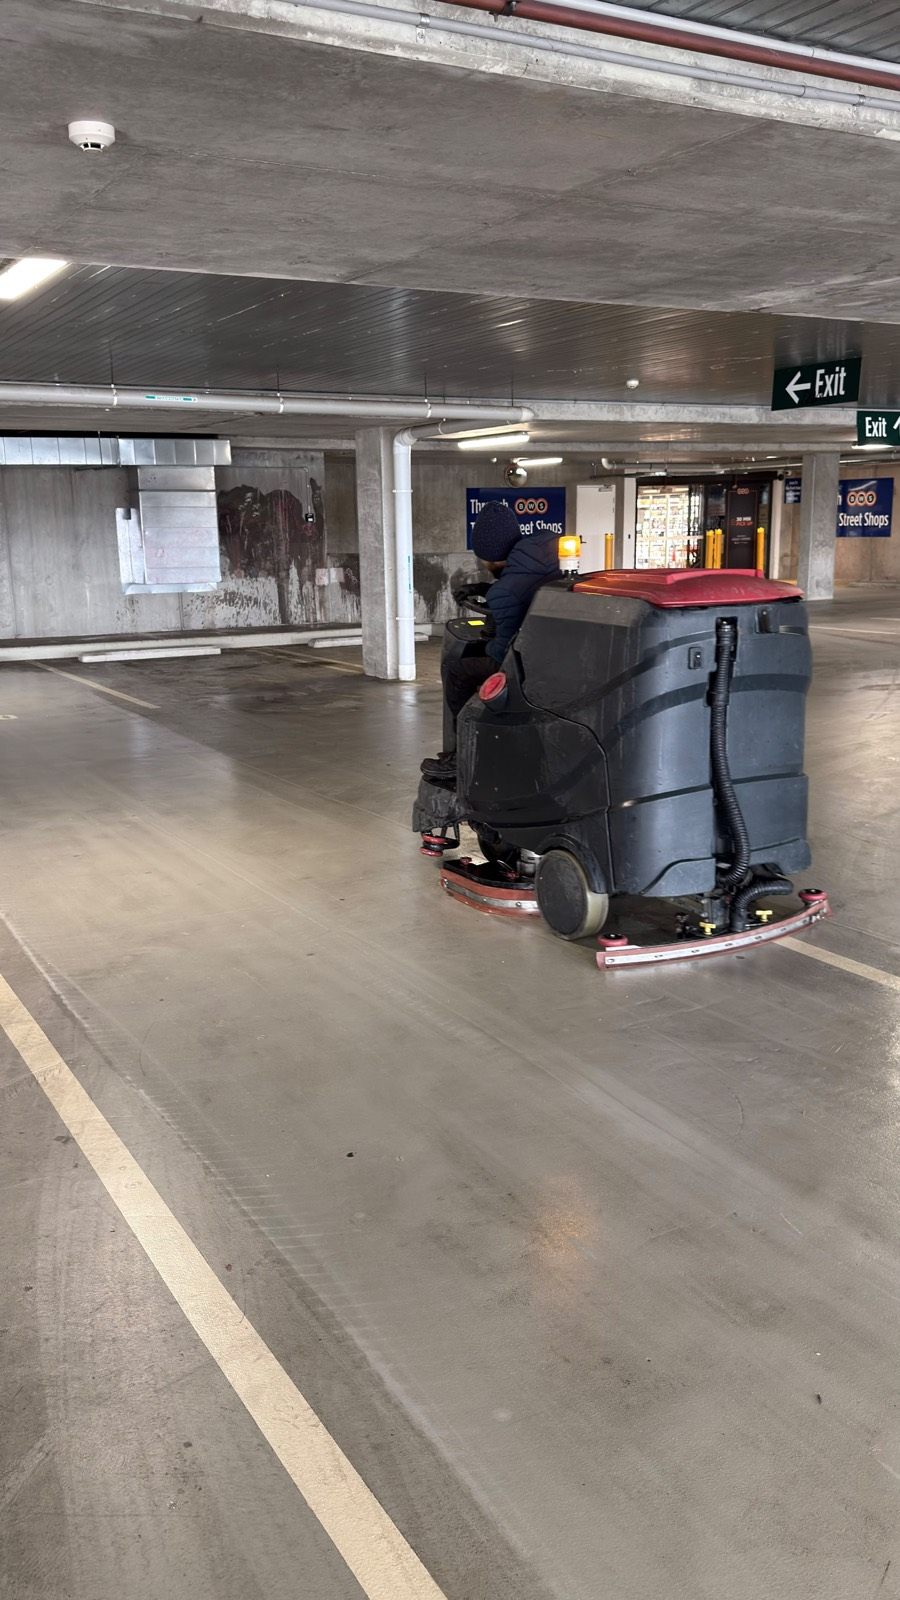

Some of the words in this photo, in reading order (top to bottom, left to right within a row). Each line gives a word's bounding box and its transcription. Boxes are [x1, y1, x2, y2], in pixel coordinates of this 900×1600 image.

[815, 366, 847, 398] Exit
[865, 416, 888, 437] Exit
[470, 499, 509, 514] Thrh
[839, 512, 863, 526] Street
[864, 512, 889, 528] Shops
